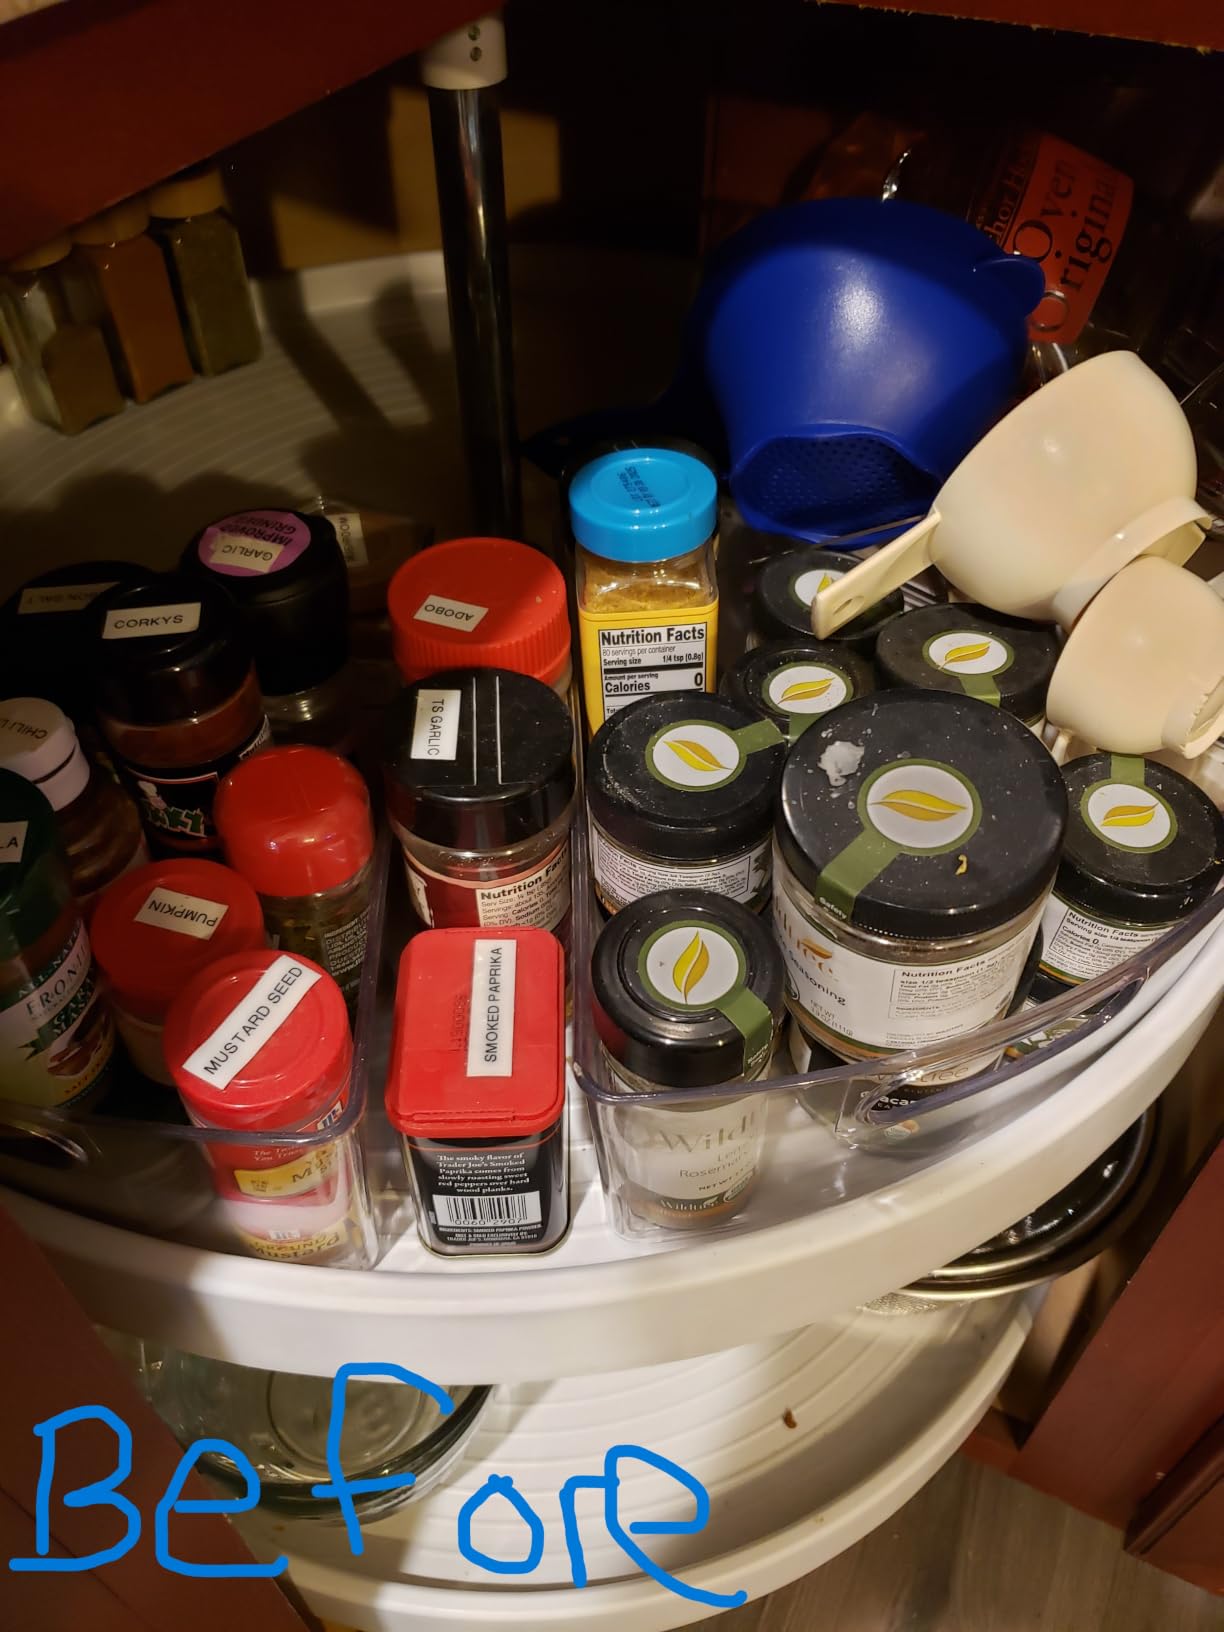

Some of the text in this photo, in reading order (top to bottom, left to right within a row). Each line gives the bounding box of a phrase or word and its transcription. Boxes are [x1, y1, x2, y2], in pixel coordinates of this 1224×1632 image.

[222, 544, 273, 561] GARLIC
[423, 603, 475, 622] ADOBO
[114, 614, 184, 630] CORKYS
[601, 626, 705, 646] Nutrition Facts
[611, 648, 636, 658] servings
[637, 647, 647, 656] per
[648, 645, 676, 654] container
[603, 658, 627, 667] Serving
[629, 657, 642, 665] size
[674, 654, 684, 663] tsp
[605, 672, 704, 693] Calories 0
[627, 674, 637, 682] per
[638, 672, 659, 681] serving
[427, 698, 445, 756] TS GARLIC
[481, 875, 542, 900] Nutrition
[148, 899, 218, 927] PUMPKIN
[512, 901, 538, 915] Calories
[515, 908, 540, 921] Sodium
[1066, 917, 1093, 934] Serving
[1094, 931, 1108, 939] size
[1068, 910, 1139, 938] Nutrition Facts
[1062, 925, 1091, 942] Calories
[901, 960, 985, 978] Nutrition Facts
[483, 946, 504, 1063] SMOKED PAPRIKA
[203, 966, 304, 1075] MUSTARD SEED
[455, 1154, 485, 1163] smoky
[486, 1153, 512, 1161] flavor
[467, 1161, 488, 1169] Joe's
[489, 1159, 525, 1168] Smoked
[509, 1177, 530, 1185] hard
[481, 1186, 514, 1194] planks.
